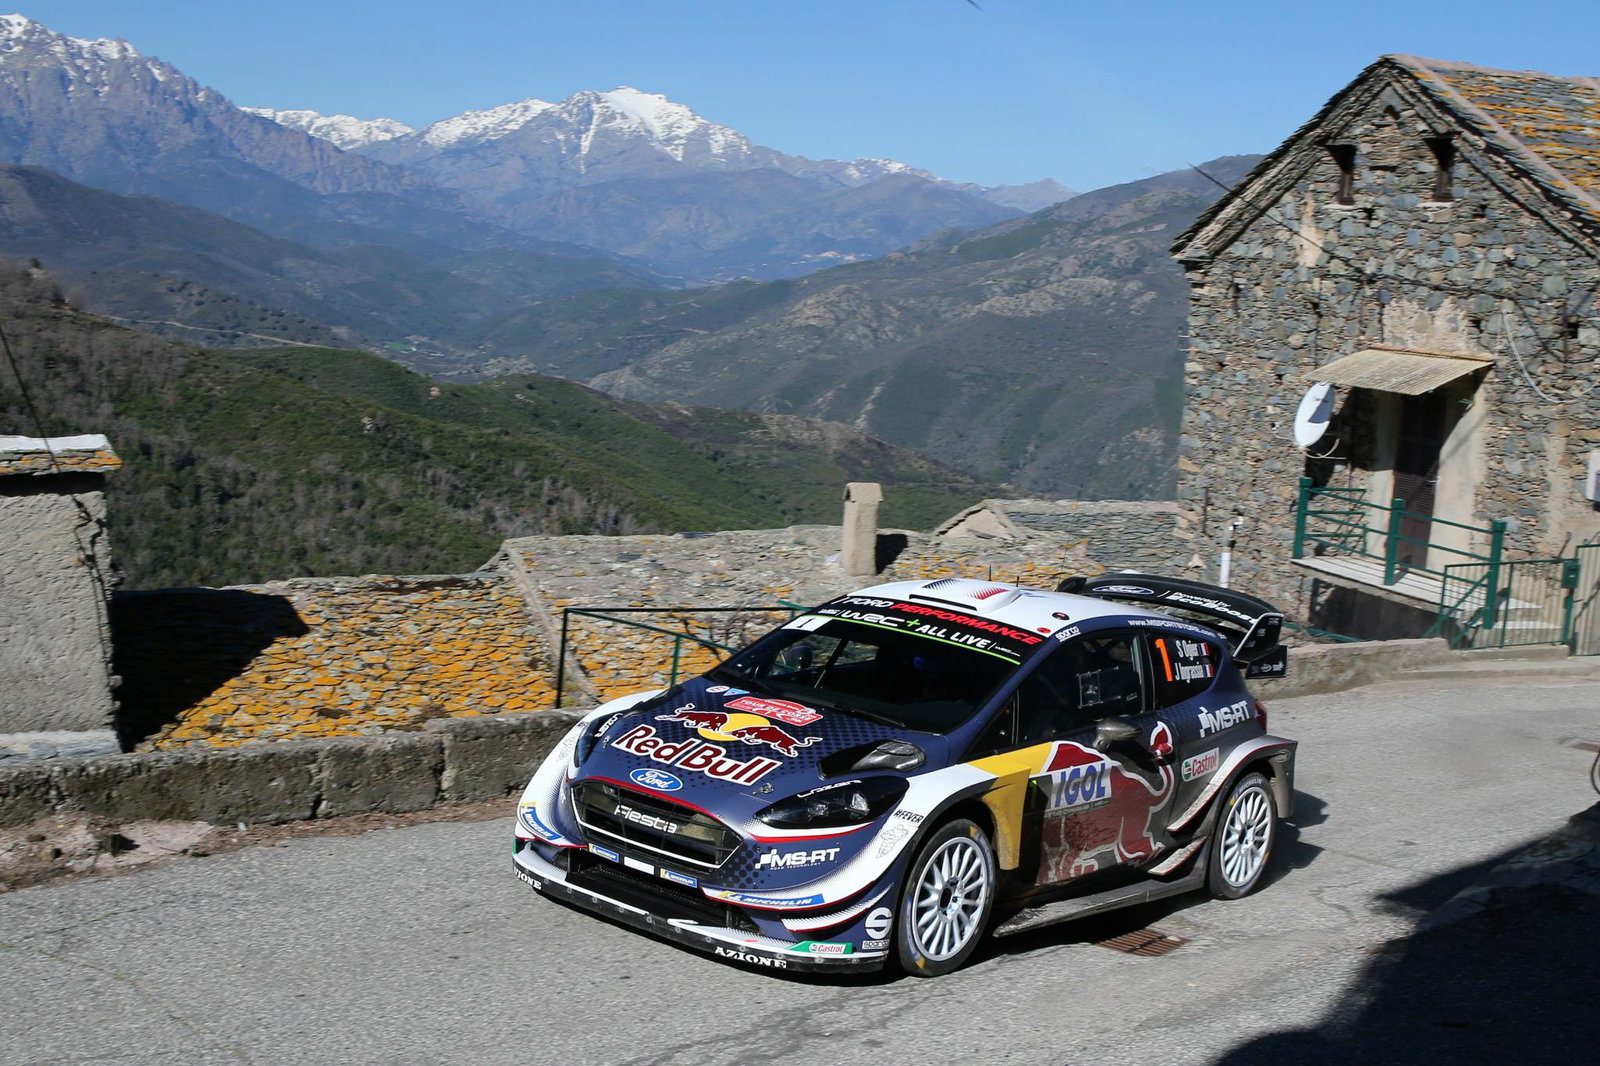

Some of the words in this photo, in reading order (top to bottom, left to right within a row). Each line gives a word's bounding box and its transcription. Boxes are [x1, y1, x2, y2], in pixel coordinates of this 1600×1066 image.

[1174, 592, 1218, 604] Powered
[841, 610, 905, 627] WRC
[915, 624, 946, 638] ALL
[950, 632, 992, 649] LIVE
[843, 597, 894, 608] FORD
[889, 602, 1043, 645] PERFORMANCE
[1055, 626, 1080, 641] sparco
[1155, 638, 1174, 682] 1
[1175, 640, 1184, 657] S
[1181, 640, 1199, 660] Ogier
[1174, 662, 1180, 681] J
[1179, 661, 1204, 684] Ingrassia
[1208, 700, 1249, 733] MS-RT
[615, 725, 696, 763] Red
[679, 744, 779, 784] Bull
[1192, 754, 1218, 777] Castrol
[636, 769, 675, 790] Ford
[1054, 762, 1106, 808] IGOL
[613, 804, 678, 834] Fiesta
[893, 809, 924, 823] #FEVER
[771, 847, 840, 867] MS-RT
[744, 897, 813, 906] MICHELIN
[715, 946, 787, 969] AZIONE
[818, 944, 843, 953] Castrol
